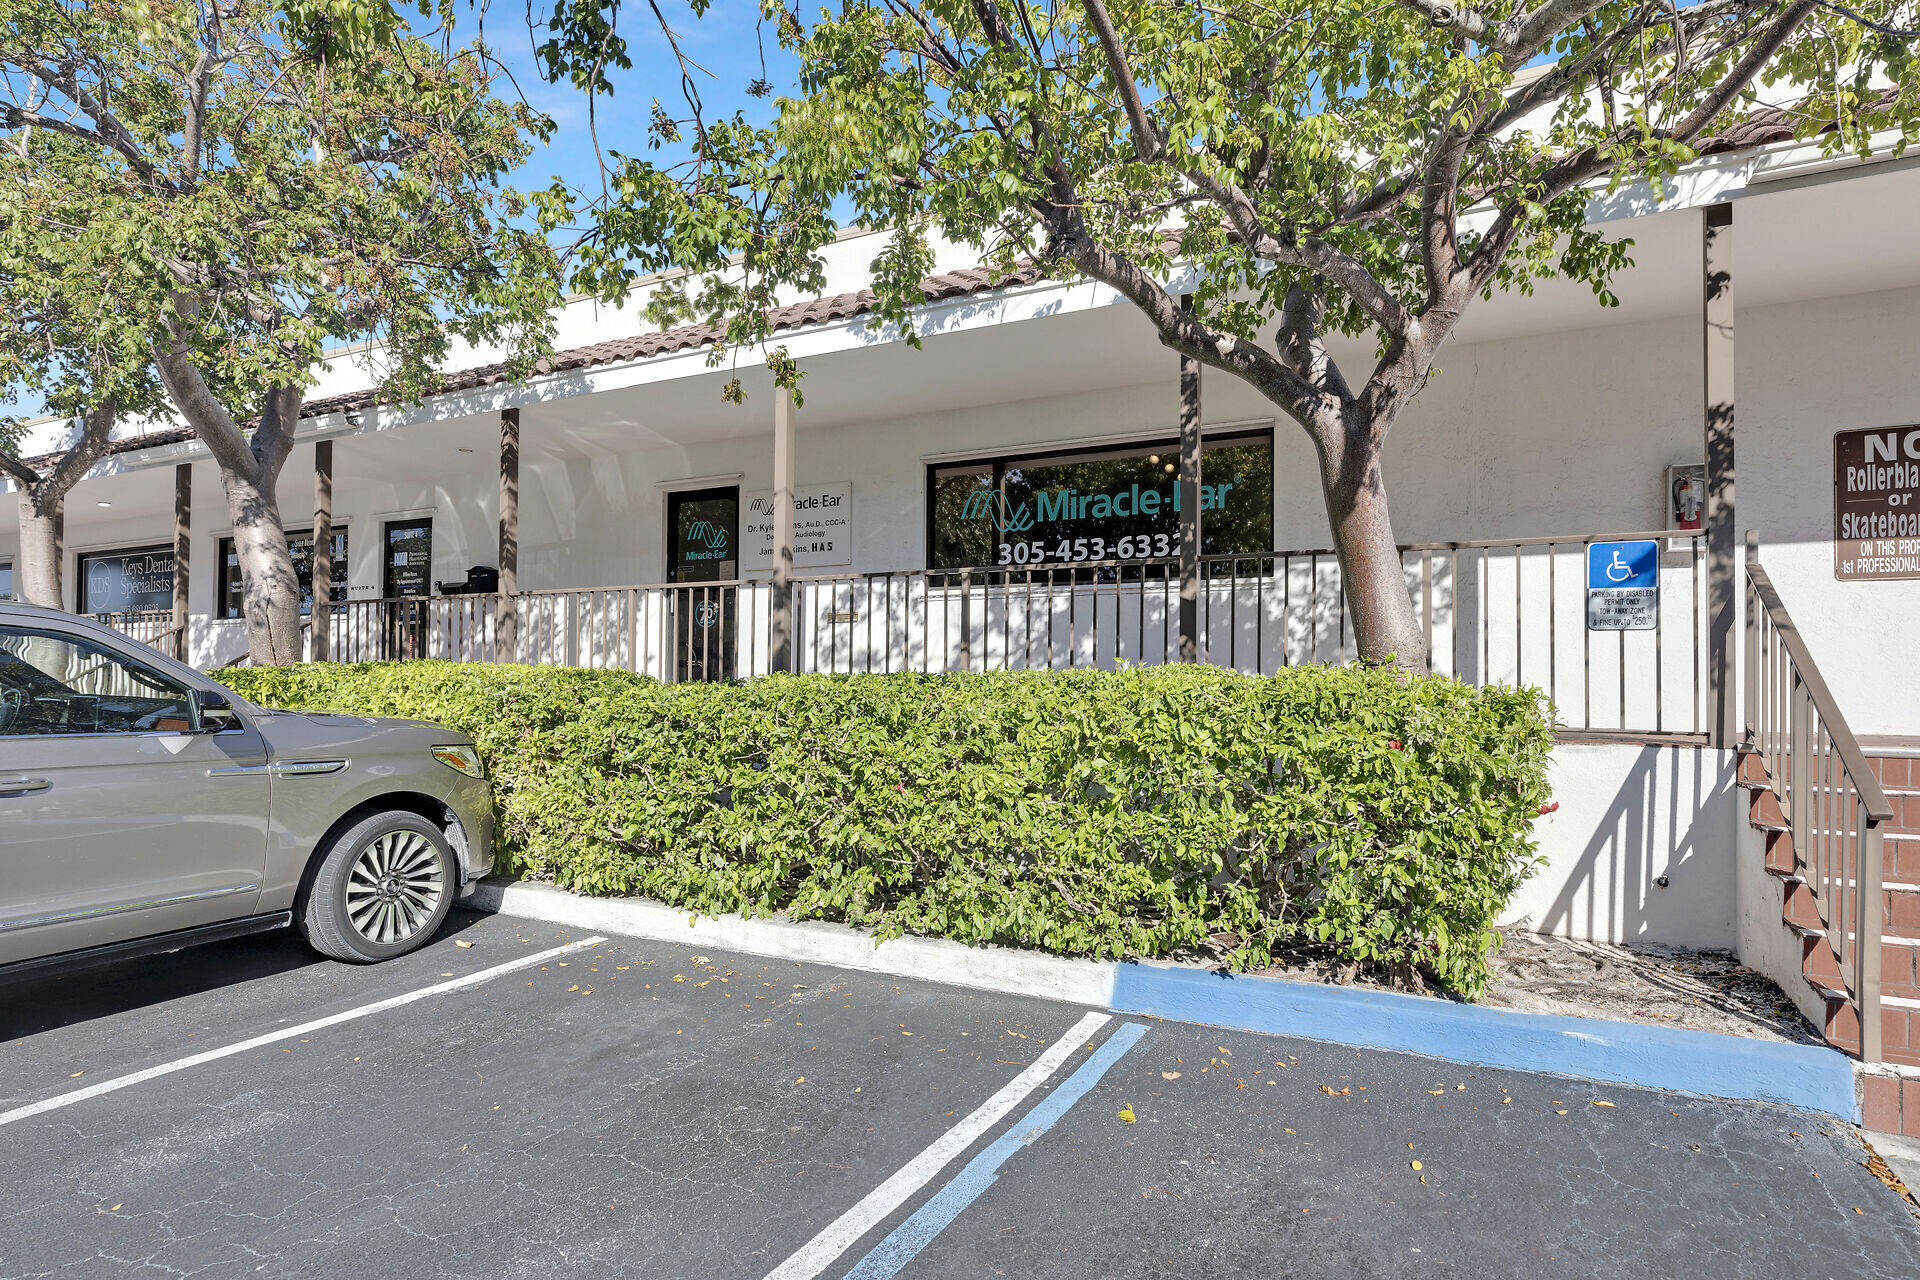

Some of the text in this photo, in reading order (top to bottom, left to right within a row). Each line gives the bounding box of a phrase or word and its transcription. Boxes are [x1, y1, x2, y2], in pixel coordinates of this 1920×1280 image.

[1888, 493, 1912, 506] or
[747, 525, 758, 533] Dr.
[825, 518, 846, 527] CCC-A
[795, 530, 826, 538] Audiology
[686, 550, 727, 560] Miracle-Ear
[998, 533, 1181, 565] 305-453-6332
[1860, 541, 1873, 556] ON
[1877, 540, 1896, 556] THIS
[121, 556, 174, 580] Keys Denta
[1842, 556, 1920, 574] 1st PROFESSIONAL
[89, 577, 110, 593] KDS
[121, 575, 170, 598] Specialists
[1616, 590, 1625, 598] BY
[1626, 590, 1654, 598] DISABLED
[1604, 598, 1624, 606] PERMIT
[1599, 607, 1629, 615] TOW-AWAY
